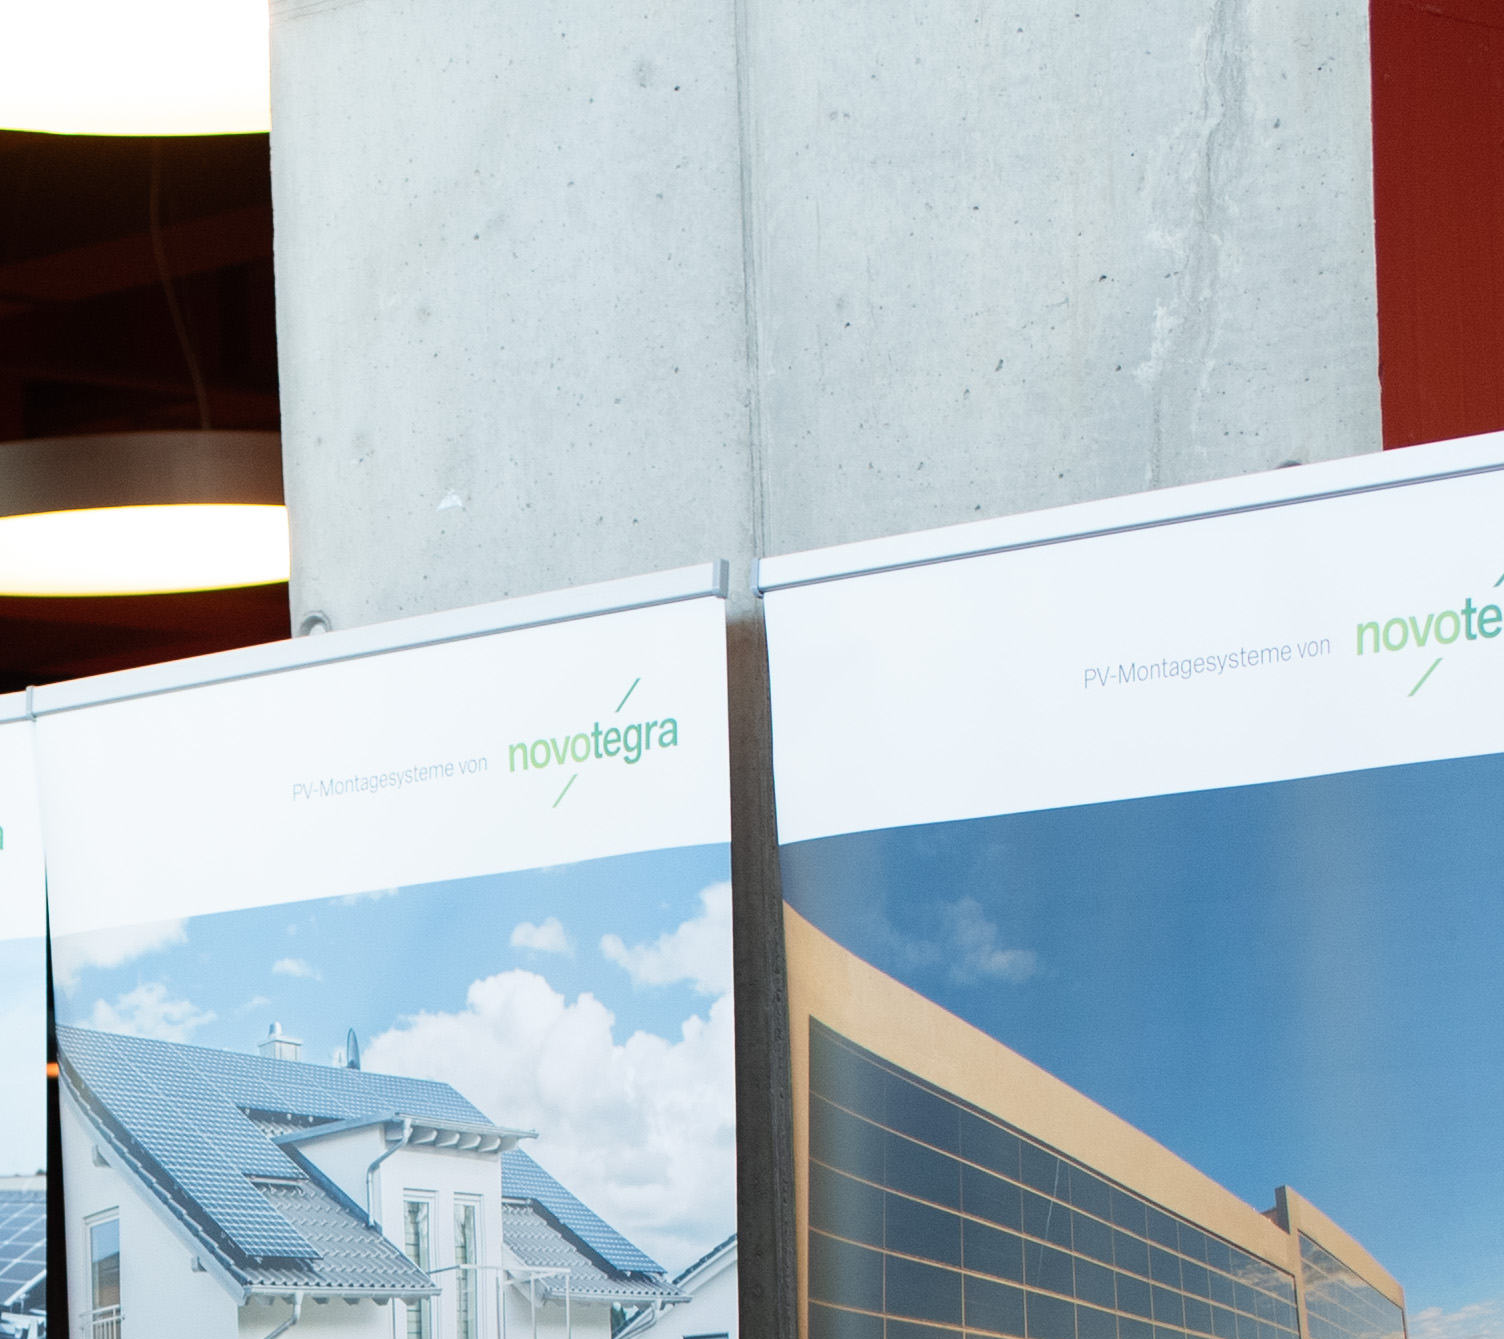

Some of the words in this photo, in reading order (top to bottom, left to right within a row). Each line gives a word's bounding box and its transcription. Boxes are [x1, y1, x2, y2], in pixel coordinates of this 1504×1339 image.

[1084, 644, 1292, 688] PV-Montagesysteme
[1298, 638, 1330, 658] von
[292, 761, 454, 801] PV-Montagesysteme
[459, 754, 487, 777] von
[508, 718, 679, 772] novotegra
